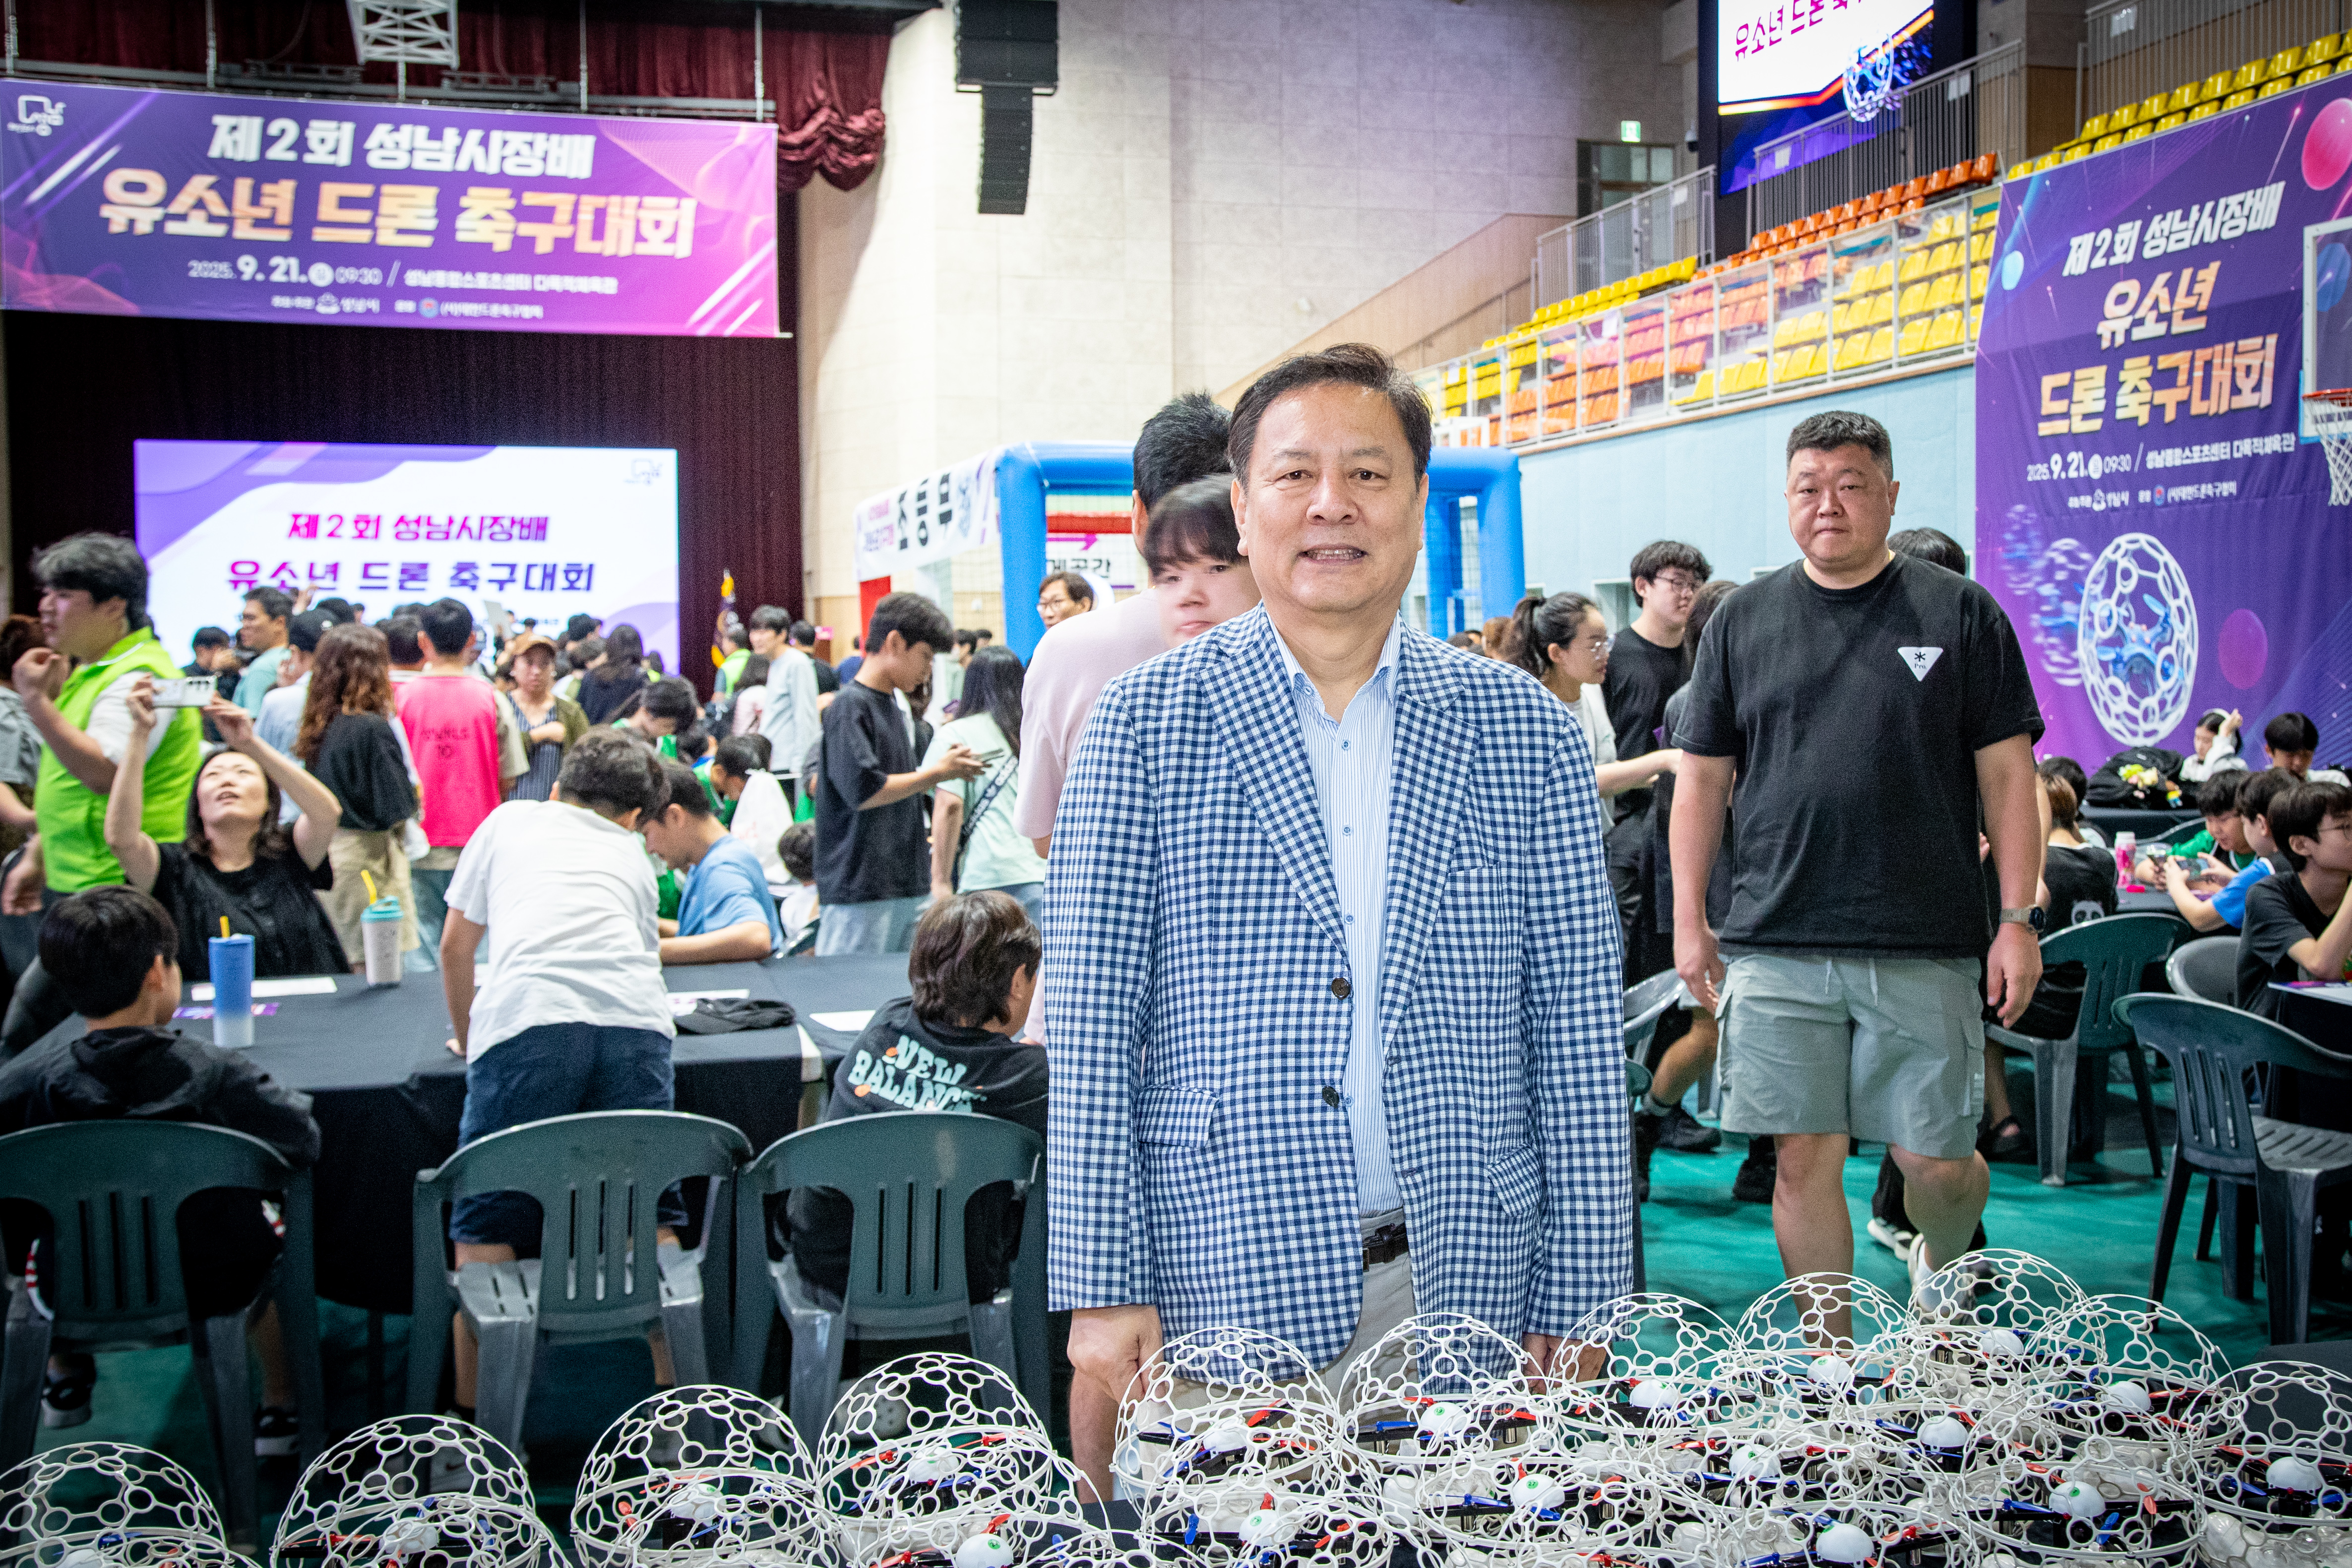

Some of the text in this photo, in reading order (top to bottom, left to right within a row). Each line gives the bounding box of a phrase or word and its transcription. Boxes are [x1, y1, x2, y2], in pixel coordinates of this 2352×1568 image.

[1735, 5, 1784, 62] 유소년
[207, 114, 597, 180] 제2회 성남시장배
[99, 168, 698, 260] 유소년 드론 축구대회
[2062, 180, 2286, 277] 제2회 성남시장배
[2096, 260, 2222, 351] 유소년
[2038, 333, 2279, 437] 드론 축구대회
[394, 514, 549, 541] 성남시장배
[227, 560, 595, 592] 유소년 드론 축구대회
[882, 1035, 967, 1085] NEW
